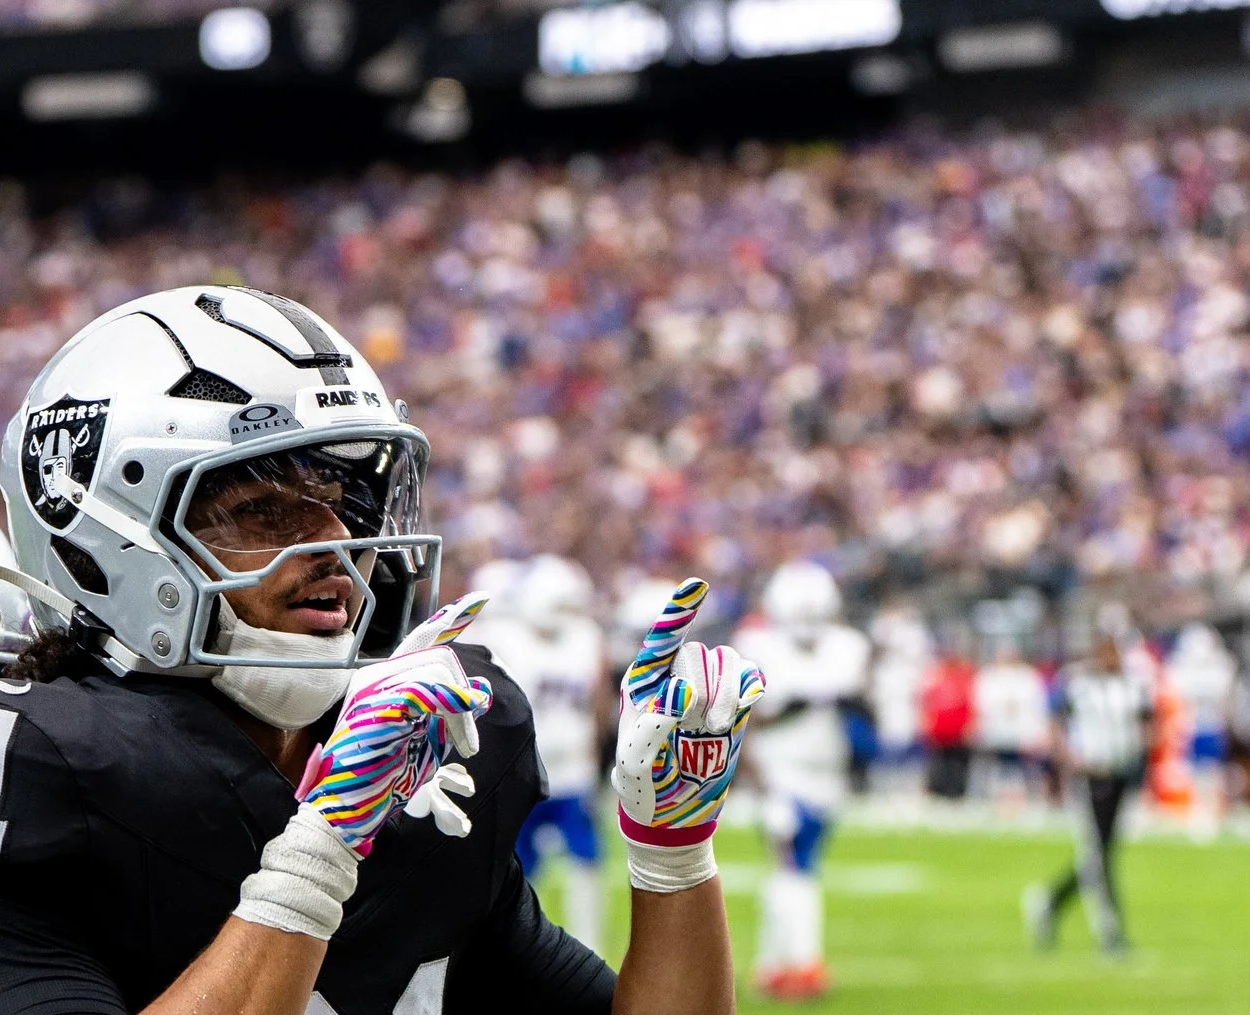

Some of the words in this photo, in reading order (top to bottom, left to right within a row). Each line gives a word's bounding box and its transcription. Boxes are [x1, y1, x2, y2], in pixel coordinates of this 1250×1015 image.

[31, 403, 99, 429] RAIDERS
[231, 418, 291, 435] OAKLEY
[680, 739, 725, 779] NFL
